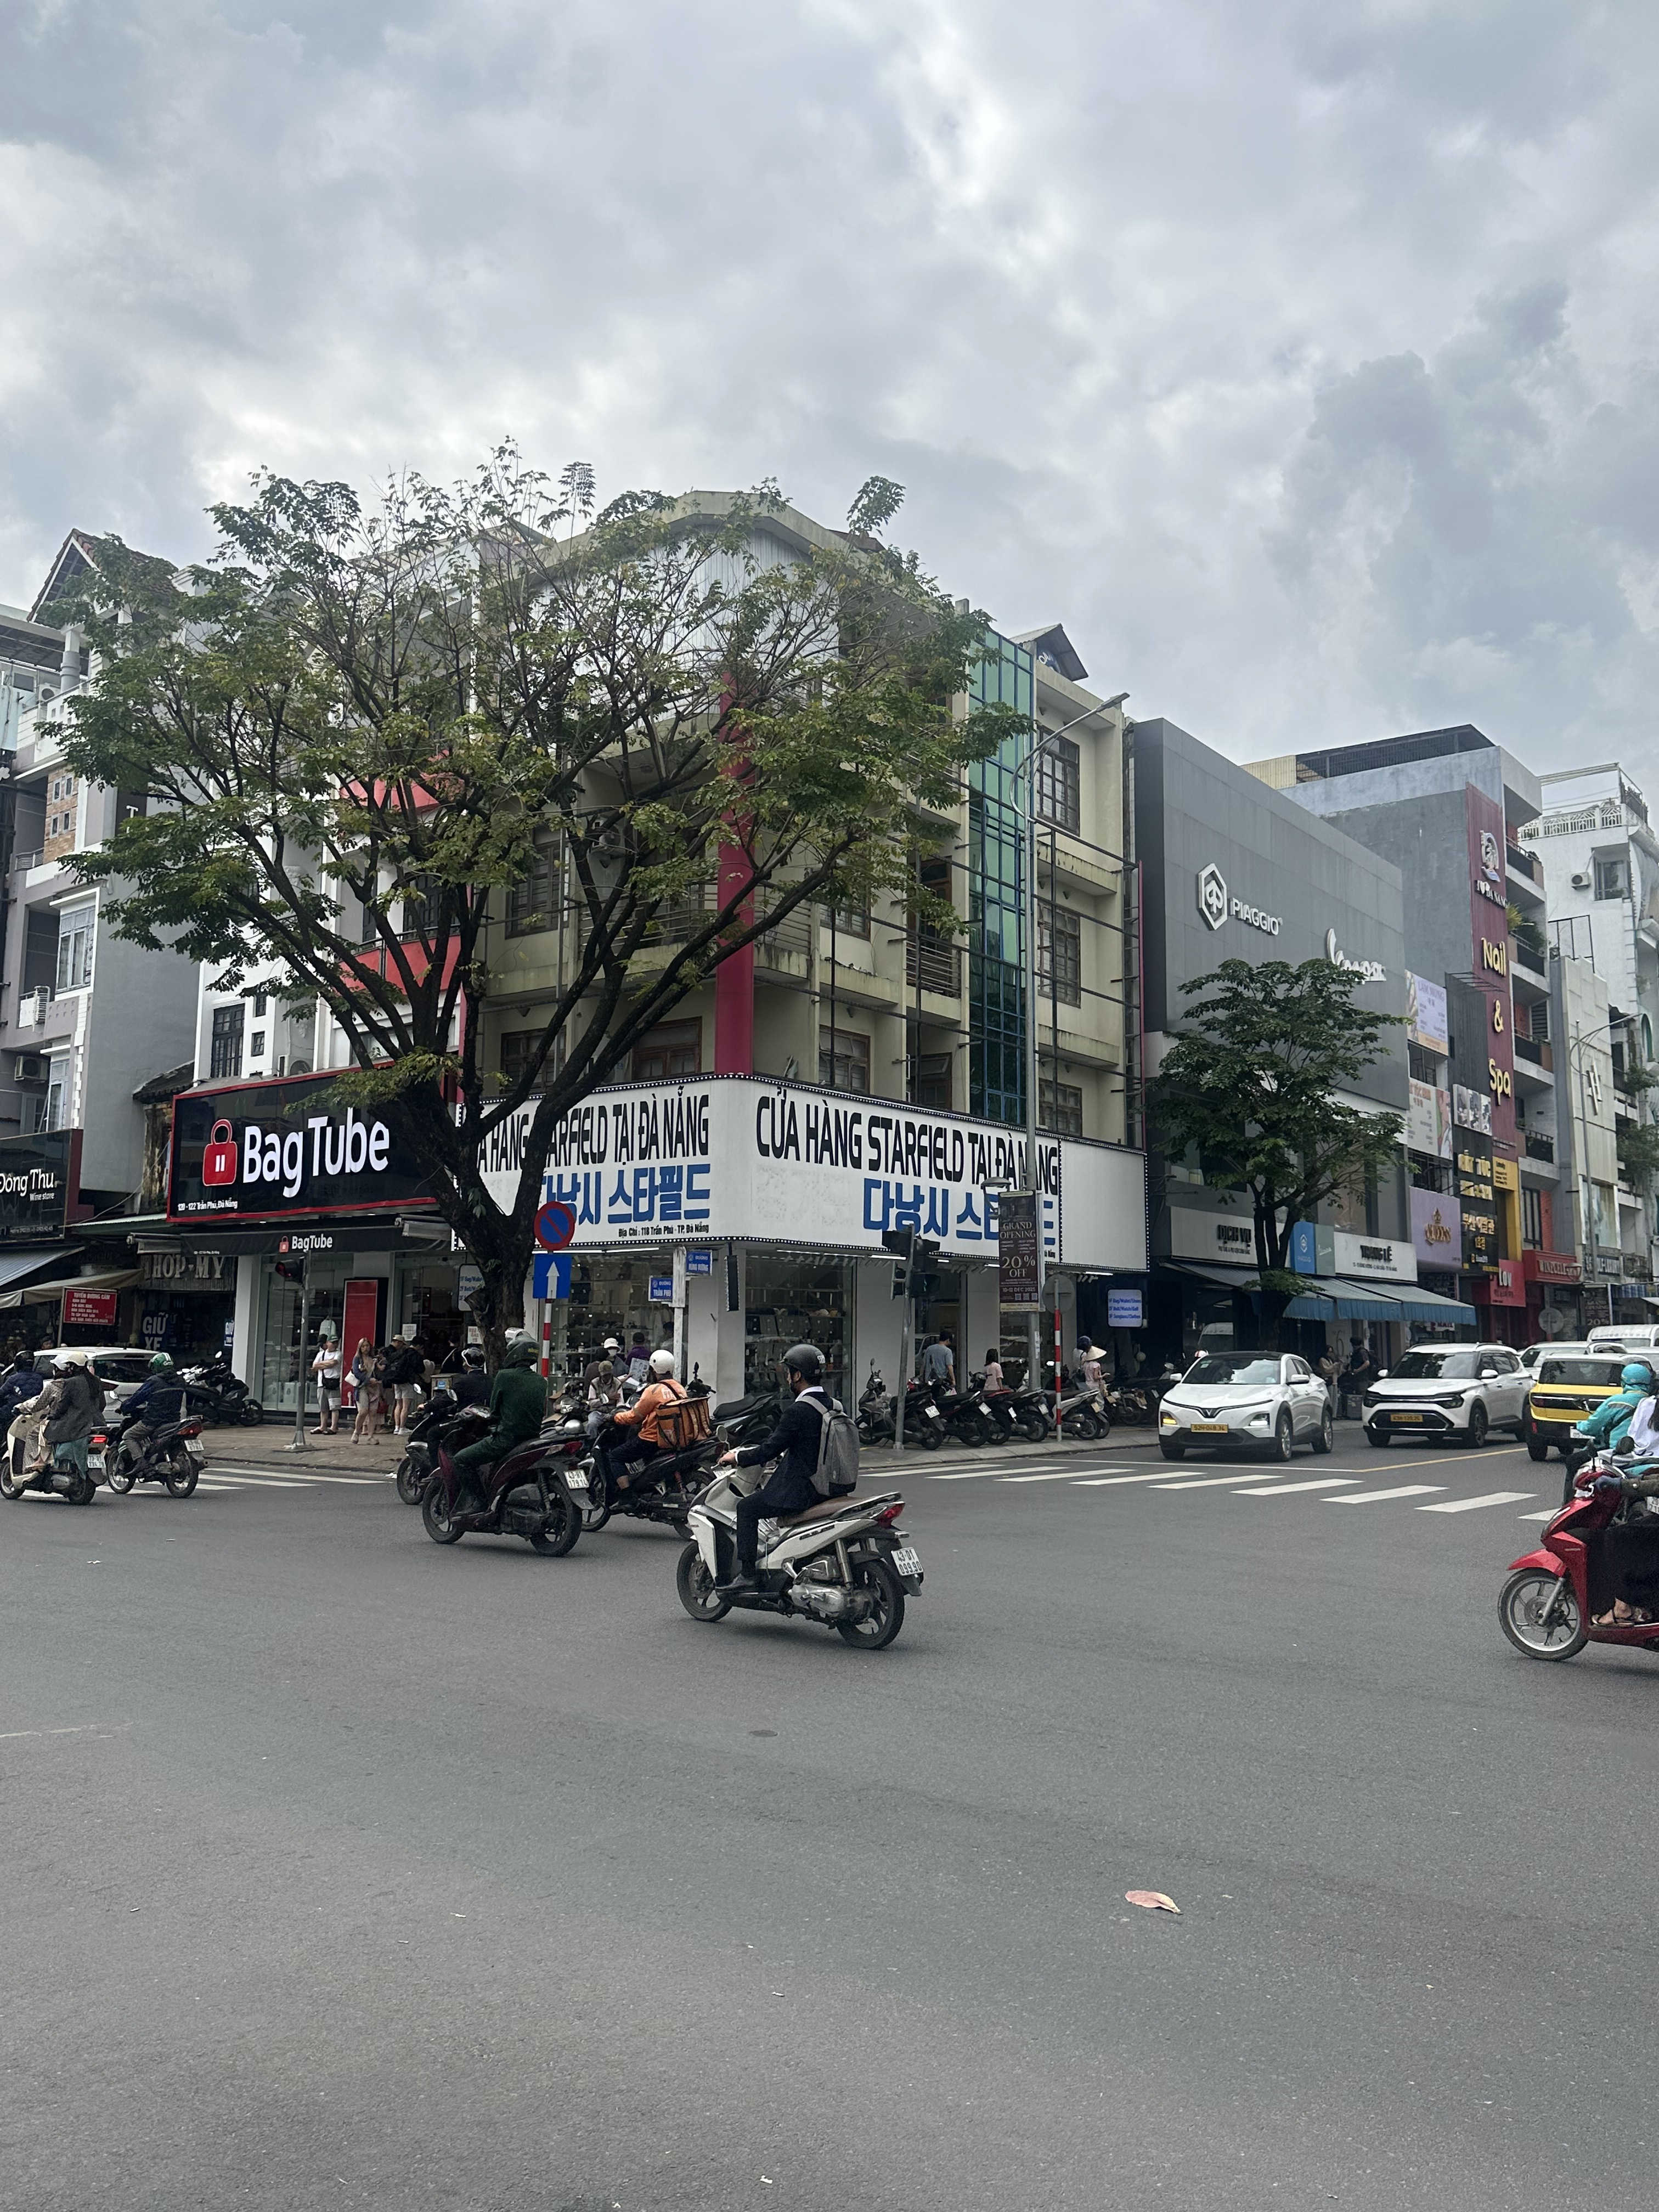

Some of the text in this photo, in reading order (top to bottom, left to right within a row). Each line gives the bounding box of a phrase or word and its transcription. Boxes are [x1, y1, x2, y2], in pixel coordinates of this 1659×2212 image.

[1231, 897, 1279, 935] PIAGGIO
[1481, 937, 1506, 977] Nail
[1493, 998, 1504, 1032] &
[1488, 1057, 1511, 1106] Spa
[547, 1105, 608, 1167] ARFIELD
[613, 1102, 635, 1165] TẠI
[638, 1093, 659, 1160] ĐÀ
[663, 1086, 709, 1159] NẴNG
[757, 1086, 800, 1161] CỬA
[806, 1099, 862, 1170] HÀNG
[868, 1115, 964, 1182] STARFIELD
[995, 1132, 1017, 1190] ĐÀ
[1018, 1141, 1058, 1195] NNG
[243, 1107, 390, 1198] BagTube
[30, 1169, 54, 1189] Thu
[607, 1164, 710, 1224] 스타필드
[863, 1178, 949, 1237] 다낭시
[1003, 1221, 1032, 1230] GRAND
[291, 1234, 332, 1252] BagTube
[641, 1226, 650, 1235] 118
[1000, 1230, 1036, 1239] OPENING
[1009, 1268, 1028, 1278] OFF
[142, 1312, 168, 1335] GIỮ
